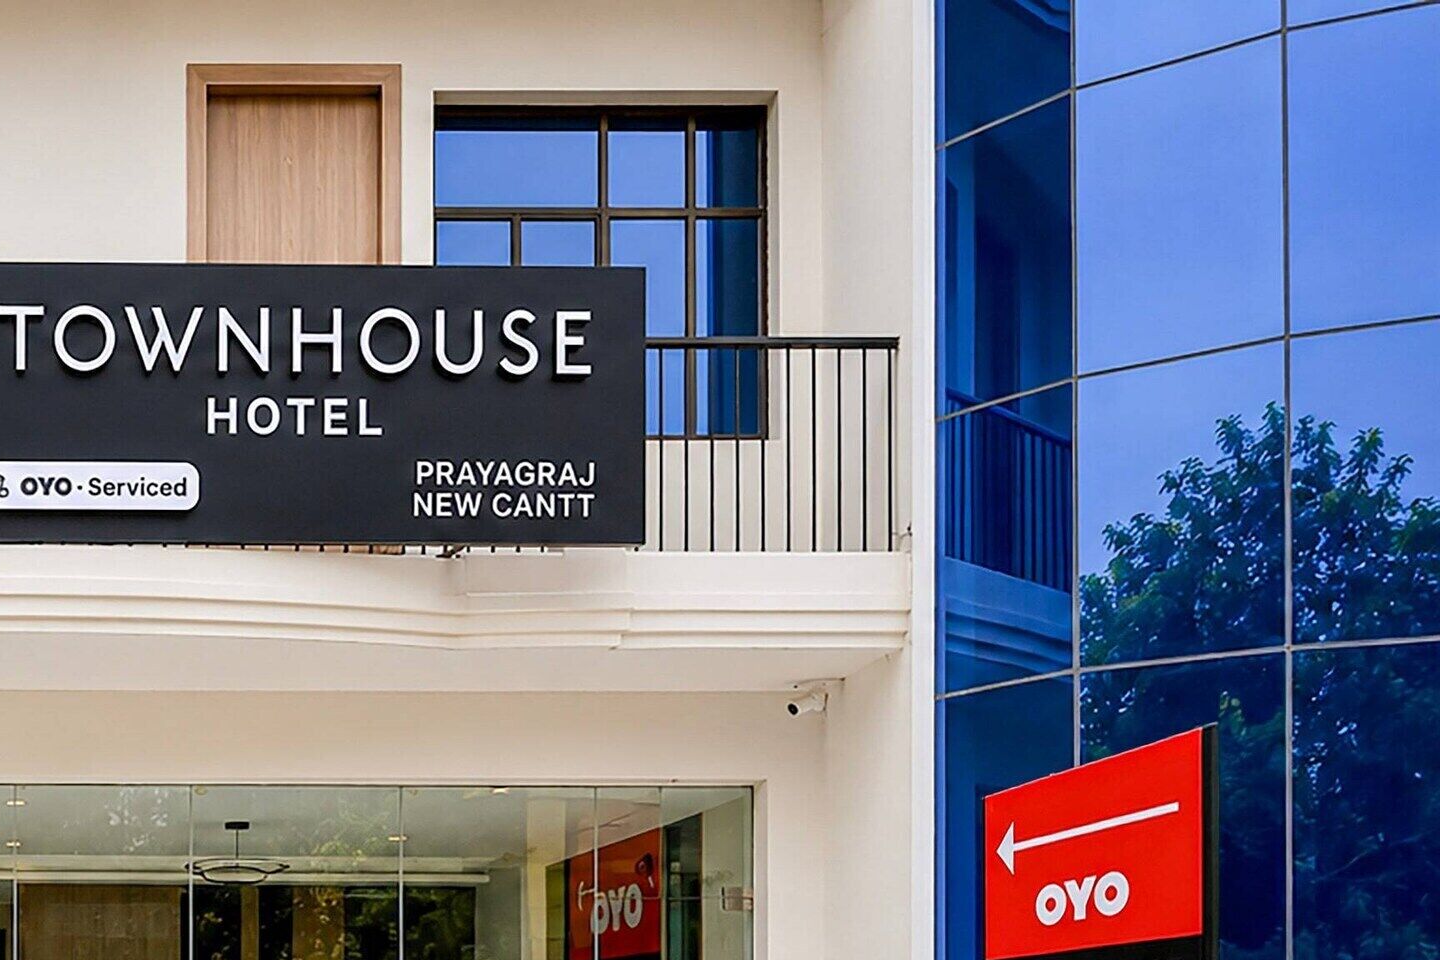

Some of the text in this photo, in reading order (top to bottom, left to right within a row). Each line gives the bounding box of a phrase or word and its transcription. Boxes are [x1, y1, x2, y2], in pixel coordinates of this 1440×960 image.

[206, 396, 383, 436] HOTEL
[20, 477, 187, 496] OYO Serviced
[416, 461, 595, 486] PRAYAGRAJ
[413, 492, 595, 518] NEW CANTT
[591, 884, 642, 934] OYO
[1035, 871, 1130, 926] OYO
